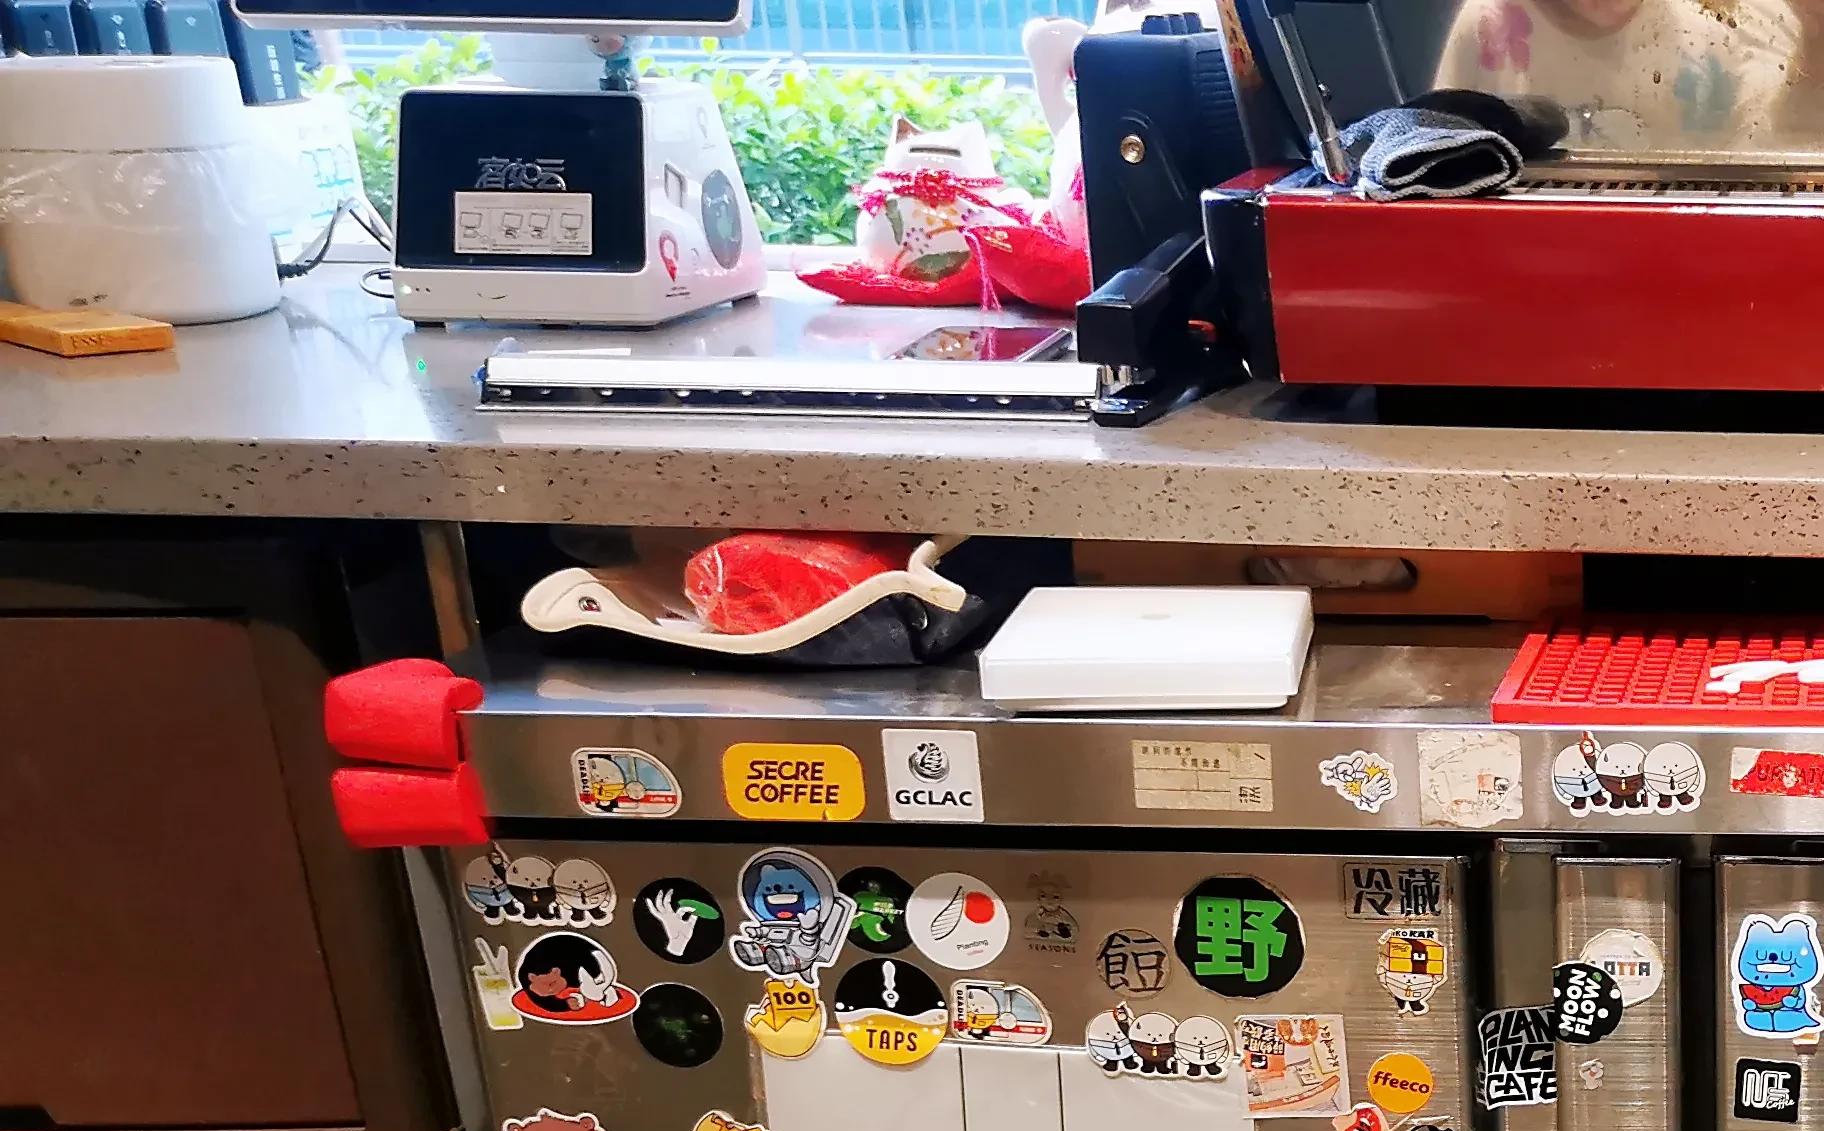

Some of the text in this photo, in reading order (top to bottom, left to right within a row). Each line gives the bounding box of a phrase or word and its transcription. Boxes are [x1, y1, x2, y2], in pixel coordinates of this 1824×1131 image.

[747, 761, 824, 782] SECRE
[745, 783, 840, 804] COFFEE
[896, 789, 973, 807] GCLAC
[1353, 868, 1442, 916] 冷藏
[1195, 896, 1287, 982] 野
[773, 991, 810, 1005] 100
[1559, 969, 1587, 1032] MOON
[1575, 977, 1602, 1036] FLOW
[866, 1029, 917, 1052] TAPS
[1372, 1070, 1430, 1095] ffeeco
[1487, 1071, 1557, 1106] CAFE
